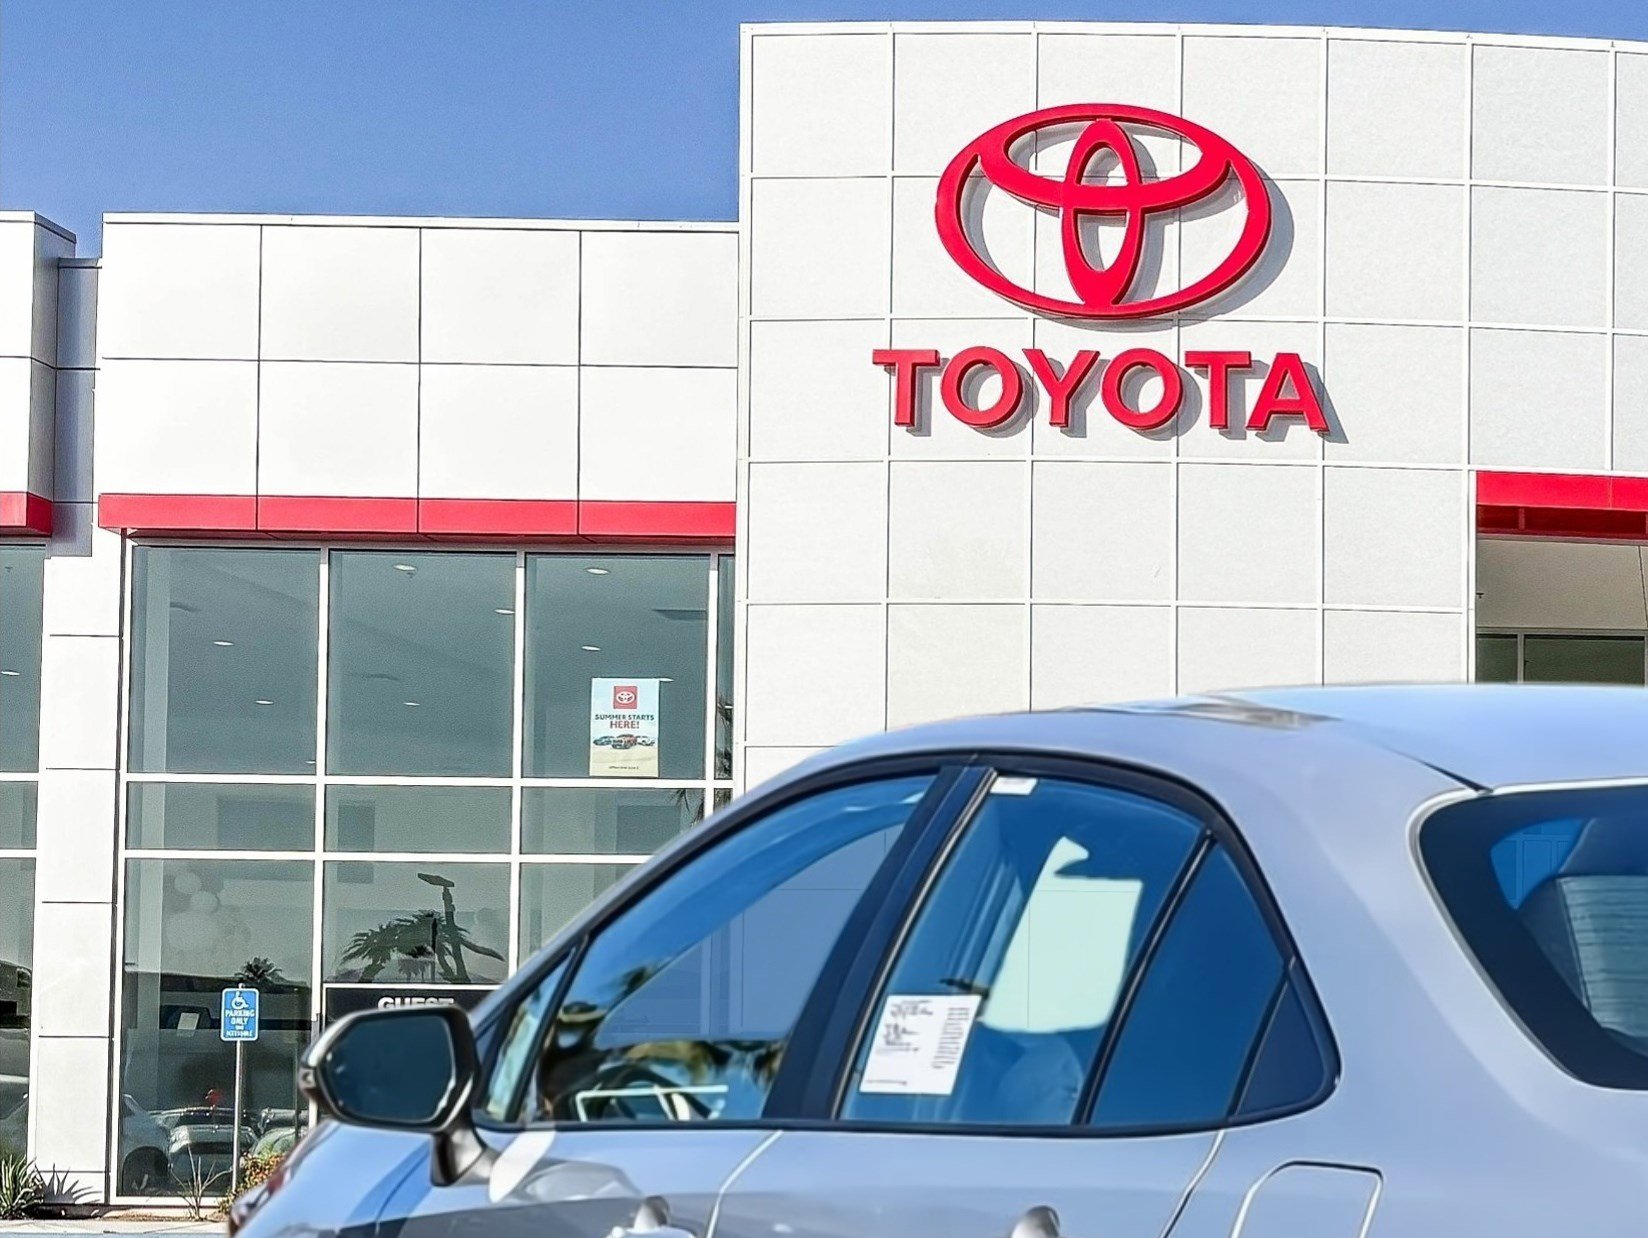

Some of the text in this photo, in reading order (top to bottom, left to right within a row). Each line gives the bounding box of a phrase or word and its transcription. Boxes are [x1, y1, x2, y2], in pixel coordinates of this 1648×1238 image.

[872, 346, 1331, 435] TOYOTA
[610, 720, 640, 729] HERE!
[225, 1009, 255, 1017] PARKING
[230, 1017, 249, 1025] ONLY
